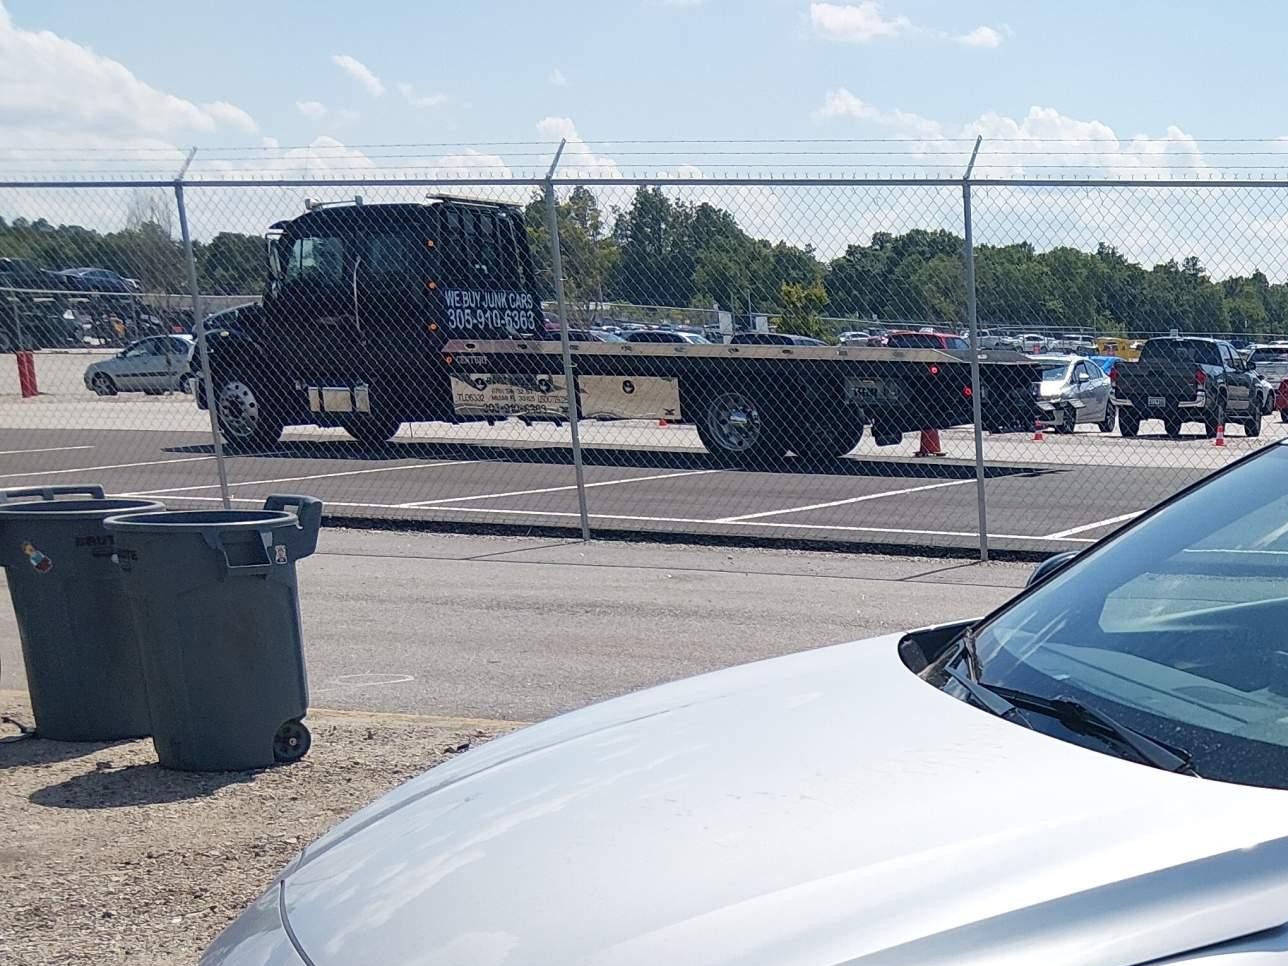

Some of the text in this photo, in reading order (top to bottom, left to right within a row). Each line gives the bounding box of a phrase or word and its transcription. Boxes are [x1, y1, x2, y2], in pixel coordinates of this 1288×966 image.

[445, 290, 533, 309] WE BUY JUNK CARS
[448, 308, 535, 330] 305-910-6363
